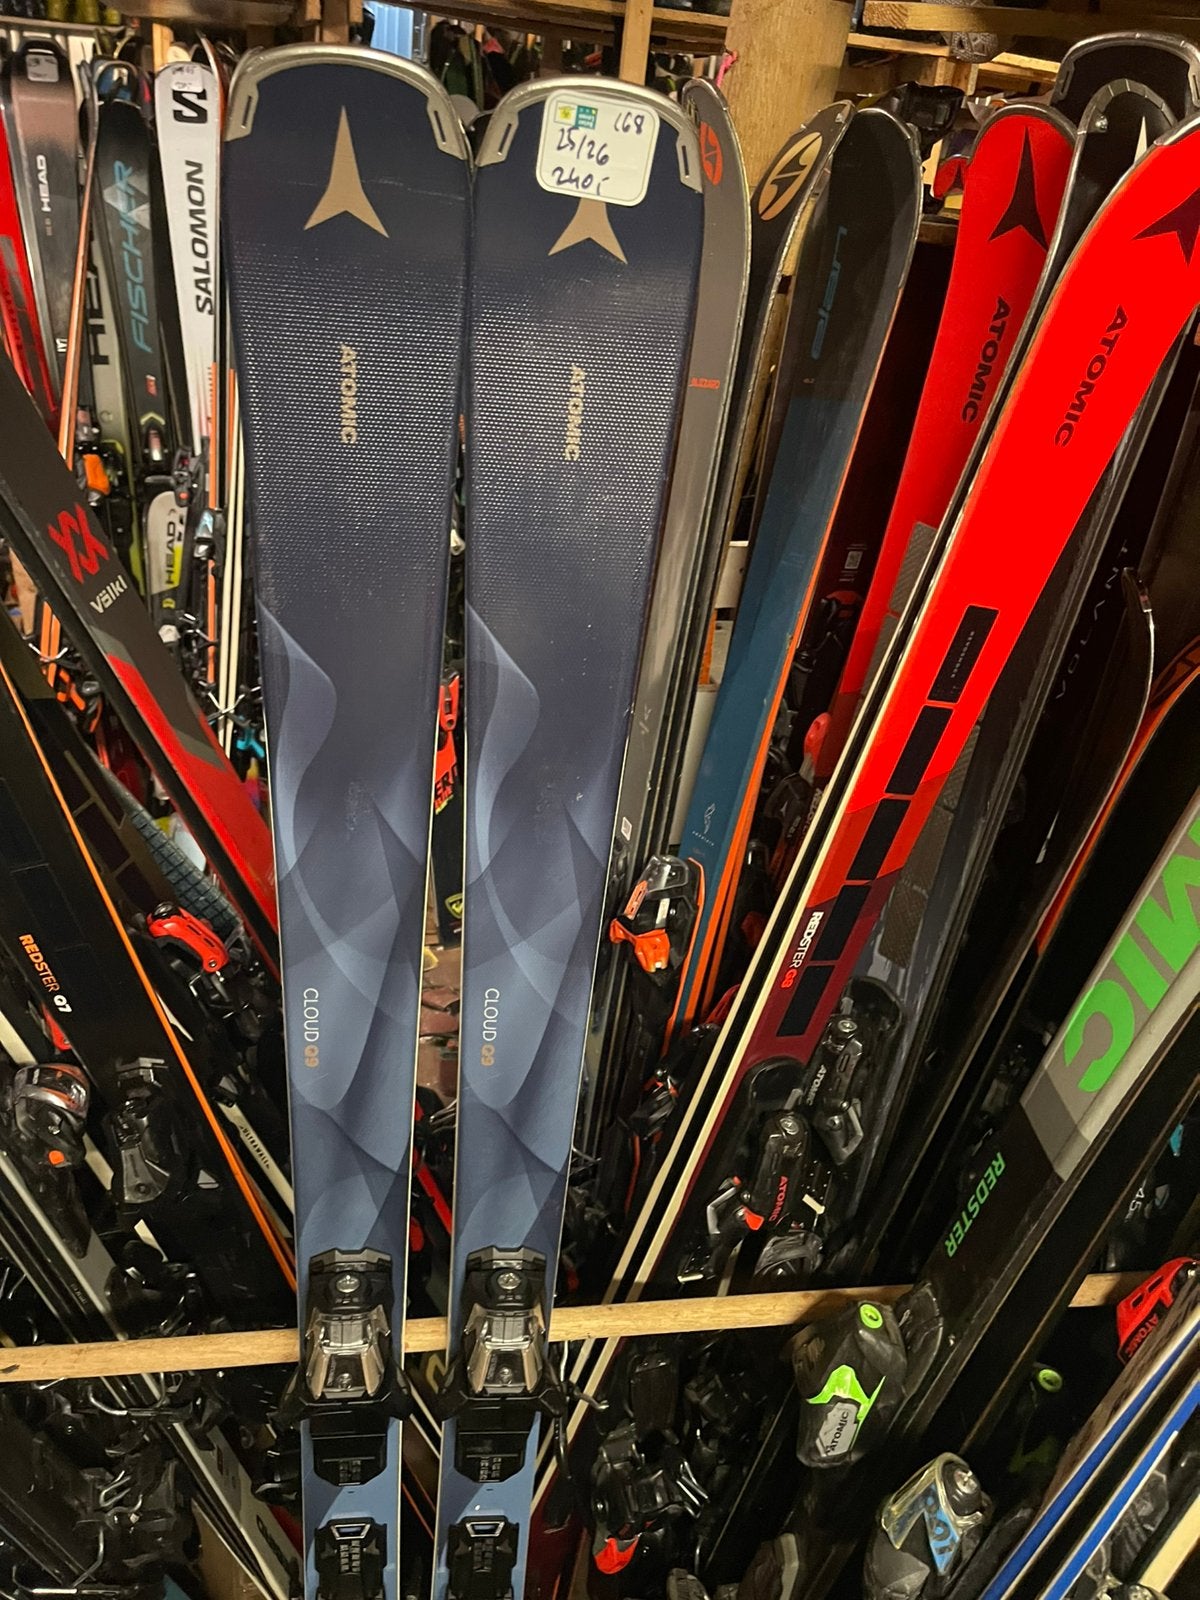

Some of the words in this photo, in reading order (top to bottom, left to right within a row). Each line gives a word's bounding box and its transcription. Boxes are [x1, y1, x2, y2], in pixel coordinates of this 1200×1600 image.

[556, 126, 609, 166] 25/26
[614, 112, 645, 135] 168
[36, 154, 51, 212] HEAD
[114, 160, 152, 352] FISCHER
[185, 160, 214, 316] SALOMON
[961, 295, 1011, 423] ATOMIC
[1054, 304, 1128, 447] ATOMIC
[340, 344, 358, 444] ATOMIC
[564, 365, 586, 461] ATOMIC
[165, 521, 176, 585] HEAD
[89, 574, 128, 613] Völkl
[19, 933, 60, 992] REDSTER
[788, 911, 824, 968] REDSTER
[303, 988, 319, 1042] CLOUD
[482, 988, 500, 1042] CLOUD
[806, 1064, 826, 1106] ATOMIC
[769, 1176, 788, 1222] ATOMIC
[945, 1152, 1006, 1257] REDSTER
[1125, 1313, 1159, 1358] ATOMIC
[825, 1411, 849, 1453] ATOMIC
